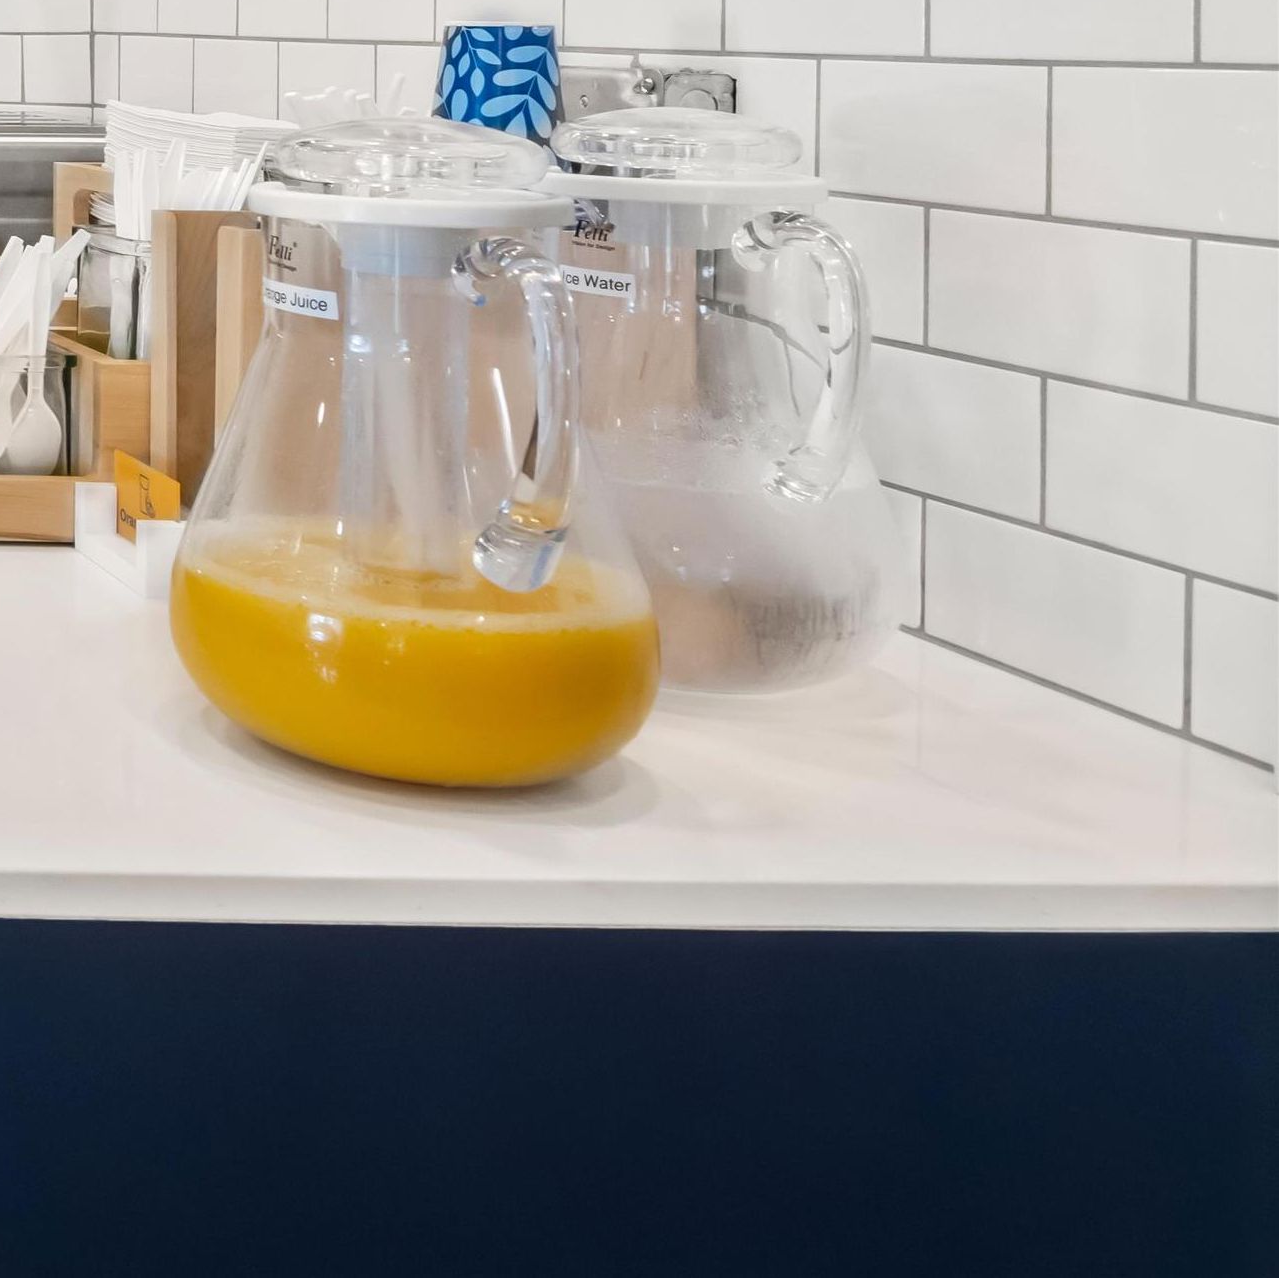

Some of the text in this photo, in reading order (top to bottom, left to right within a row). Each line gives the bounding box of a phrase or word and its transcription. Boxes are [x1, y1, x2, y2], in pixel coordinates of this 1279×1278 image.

[574, 220, 608, 242] Felli
[584, 273, 632, 292] Water
[289, 292, 328, 312] Juice
